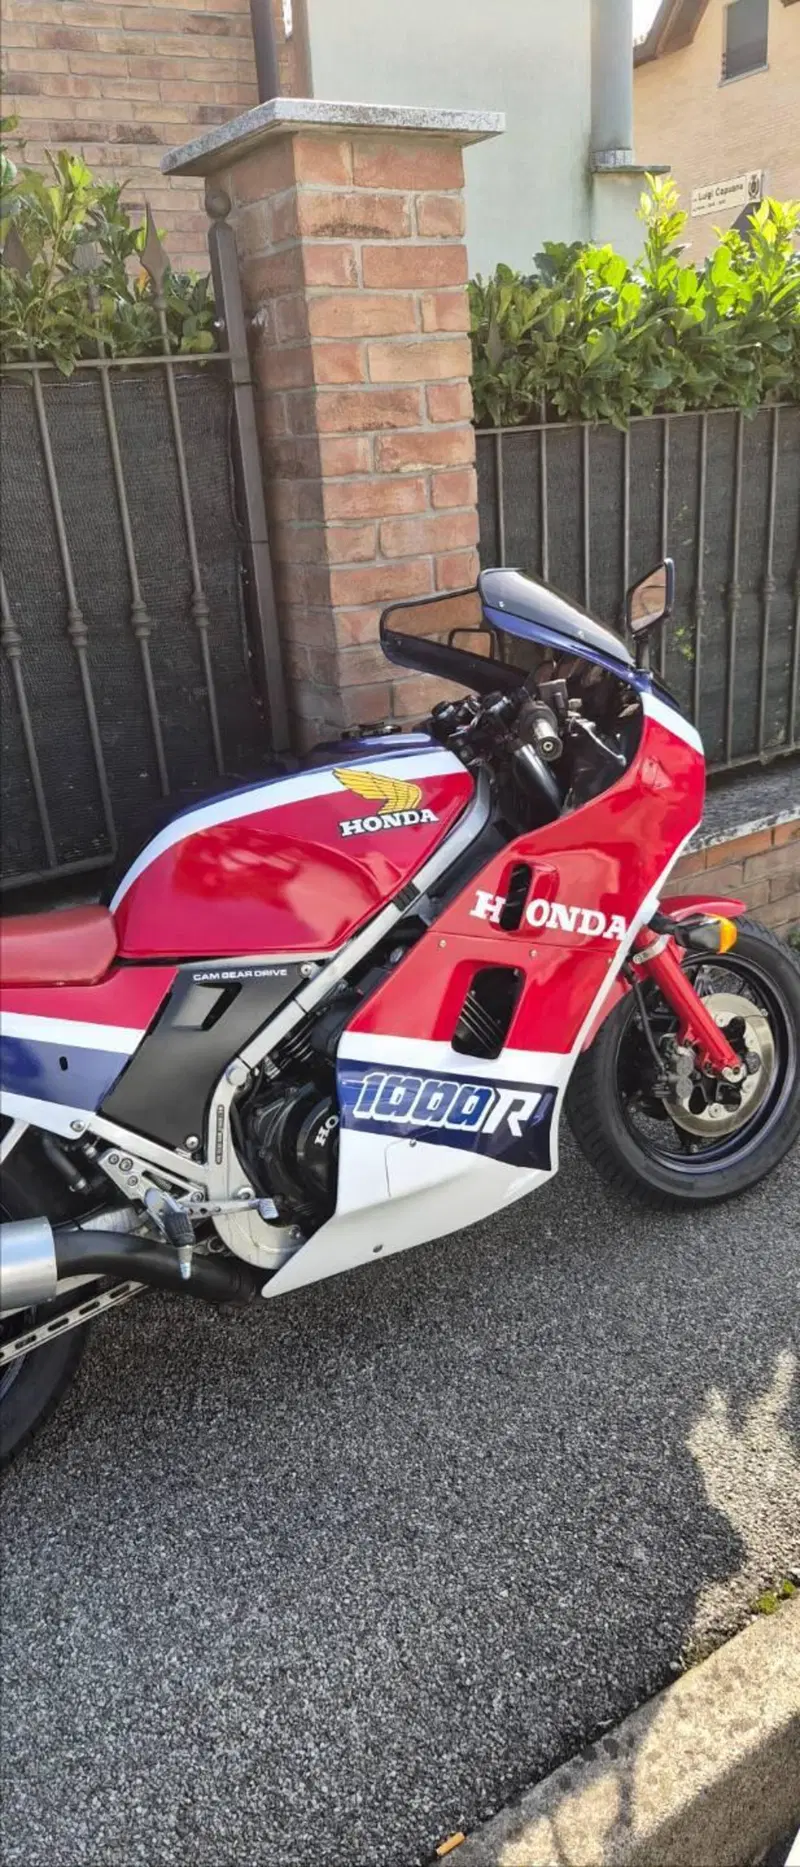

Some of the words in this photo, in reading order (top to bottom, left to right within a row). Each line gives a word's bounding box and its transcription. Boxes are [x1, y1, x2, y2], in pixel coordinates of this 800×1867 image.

[339, 808, 440, 837] HONDA
[469, 889, 627, 941] HONDA
[193, 972, 220, 981] CAM
[221, 970, 253, 979] GEAR
[254, 969, 288, 977] DRIVE
[352, 1071, 542, 1138] 1000R
